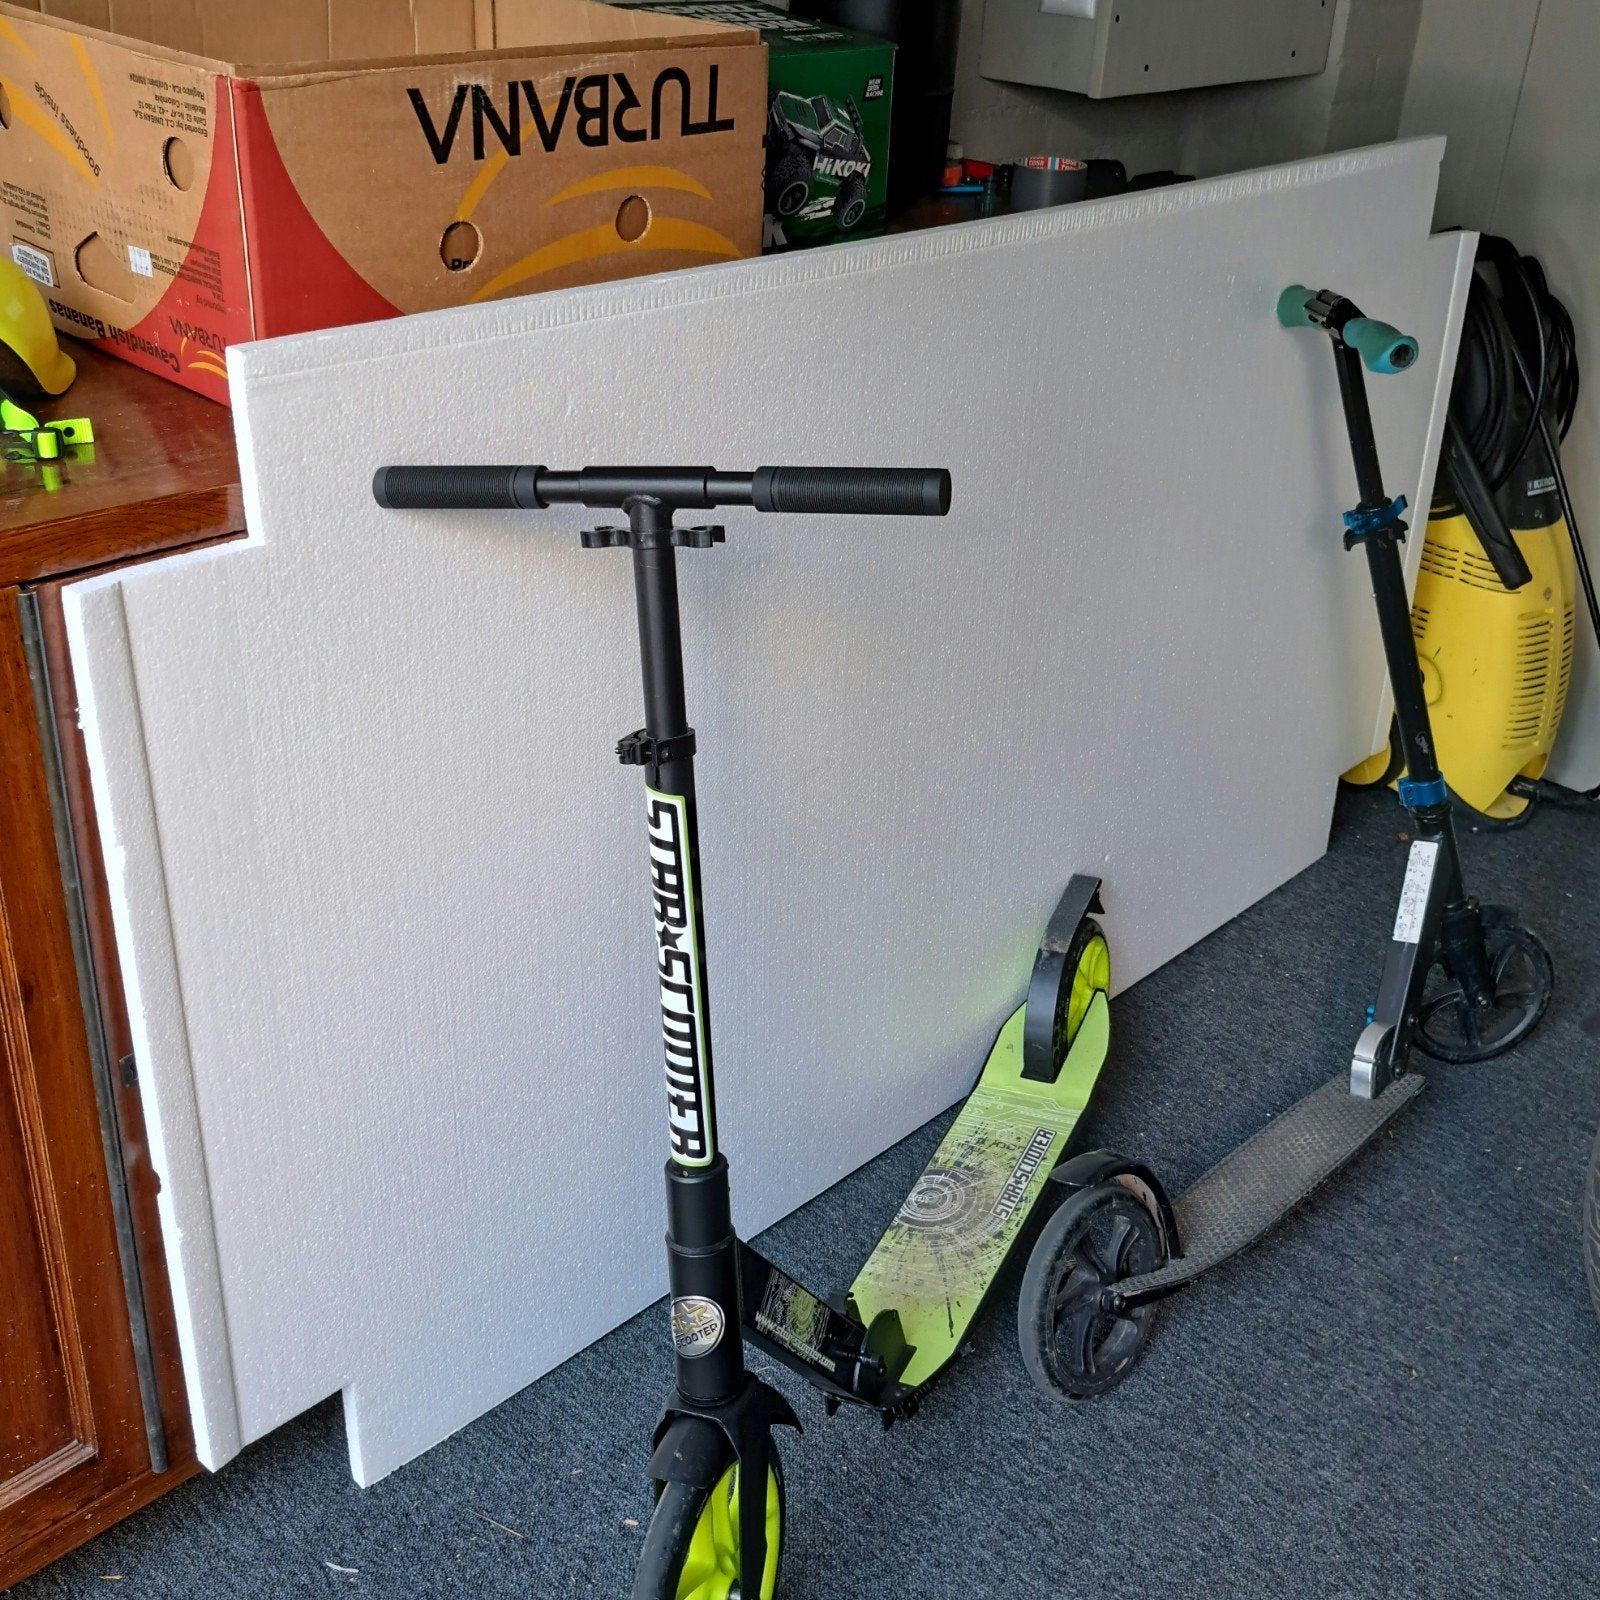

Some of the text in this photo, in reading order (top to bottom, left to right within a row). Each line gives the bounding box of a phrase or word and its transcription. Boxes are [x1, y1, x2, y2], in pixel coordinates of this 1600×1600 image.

[35, 82, 101, 177] goodness inside
[406, 64, 735, 165] TURBANA
[49, 298, 181, 373] Cavendish Bananas
[646, 799, 707, 1160] STAR SCOOTER
[676, 1323, 718, 1349] SCOOTER
